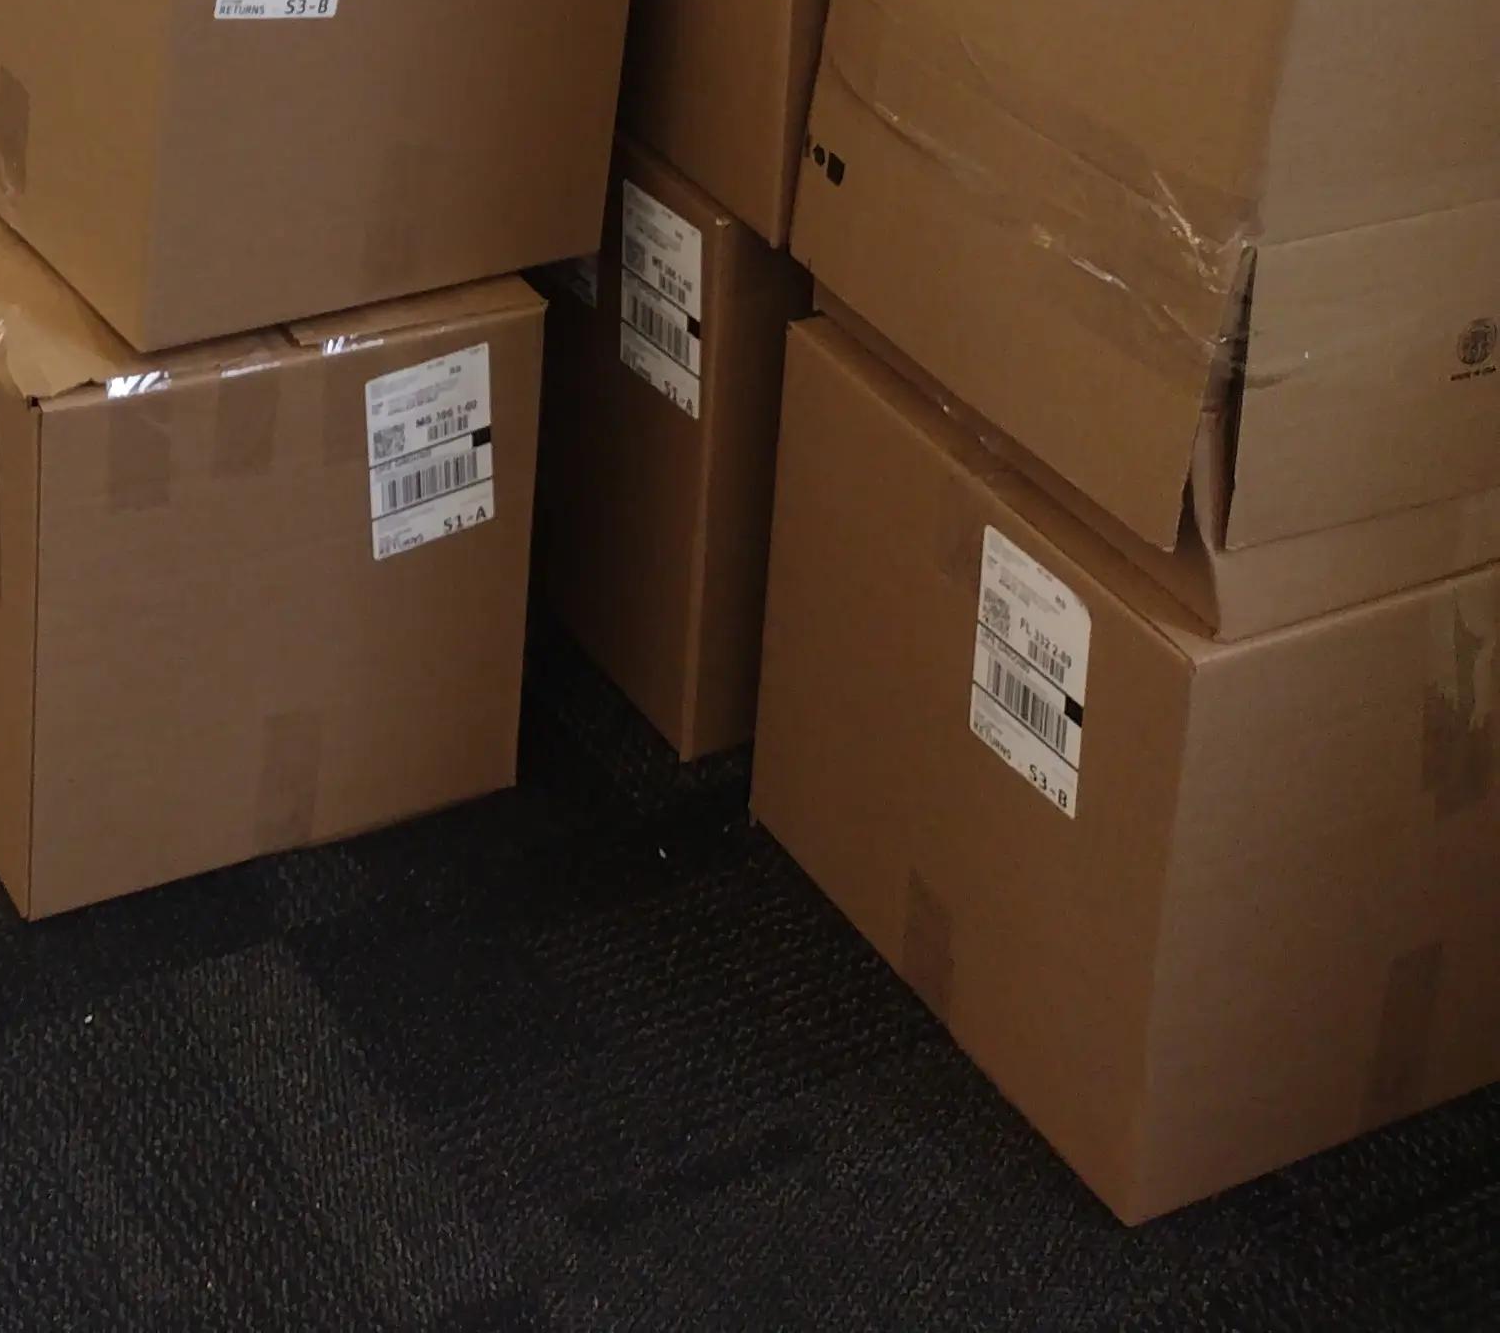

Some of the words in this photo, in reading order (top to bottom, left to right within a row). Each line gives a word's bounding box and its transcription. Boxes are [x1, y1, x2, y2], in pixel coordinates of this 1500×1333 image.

[218, 4, 265, 16] RETURNS
[443, 505, 488, 534] S1-A
[1028, 763, 1069, 809] S3-B
